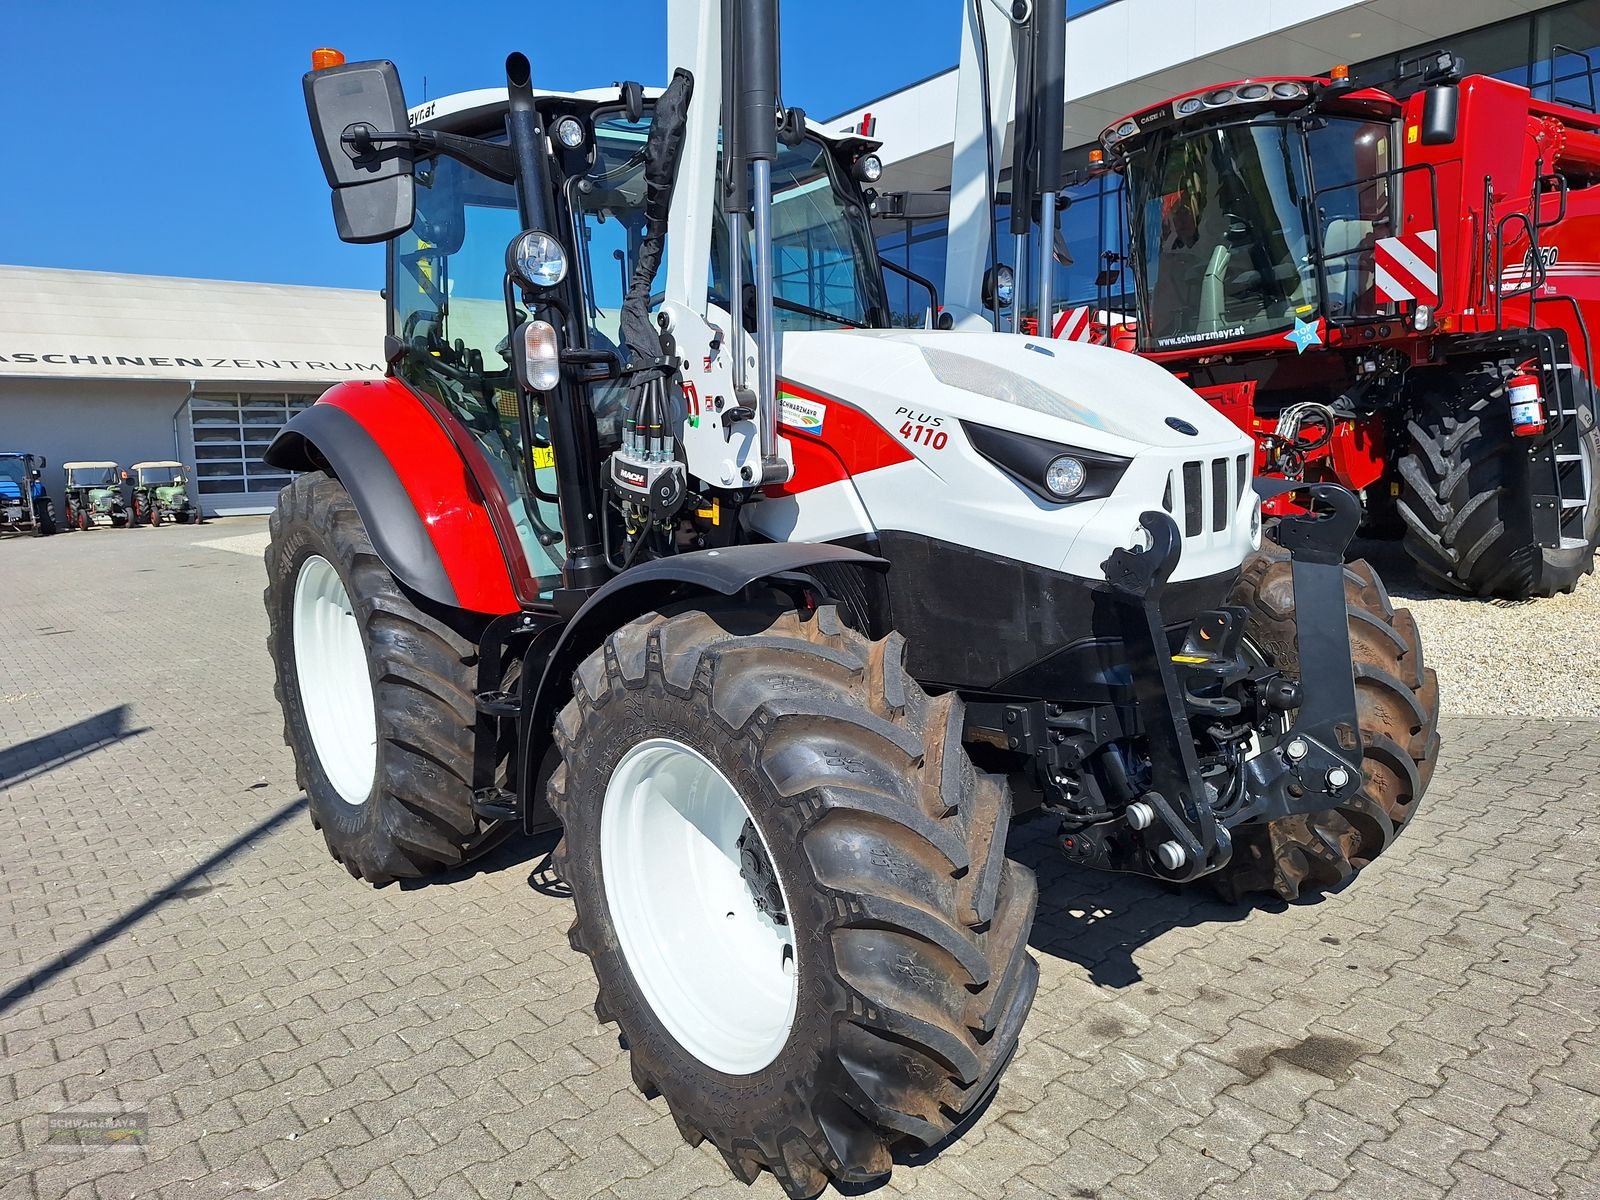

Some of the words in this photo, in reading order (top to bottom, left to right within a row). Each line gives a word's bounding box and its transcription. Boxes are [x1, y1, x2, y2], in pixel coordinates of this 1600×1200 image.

[1140, 113, 1159, 124] CASE
[1157, 325, 1245, 347] www.schwarzmayr.at
[1294, 324, 1311, 337] TOP
[1301, 333, 1313, 344] 20
[779, 400, 818, 417] SCHWARZMAYR
[895, 406, 945, 427] PLUS
[899, 420, 949, 451] 4110
[620, 469, 644, 483] MACH
